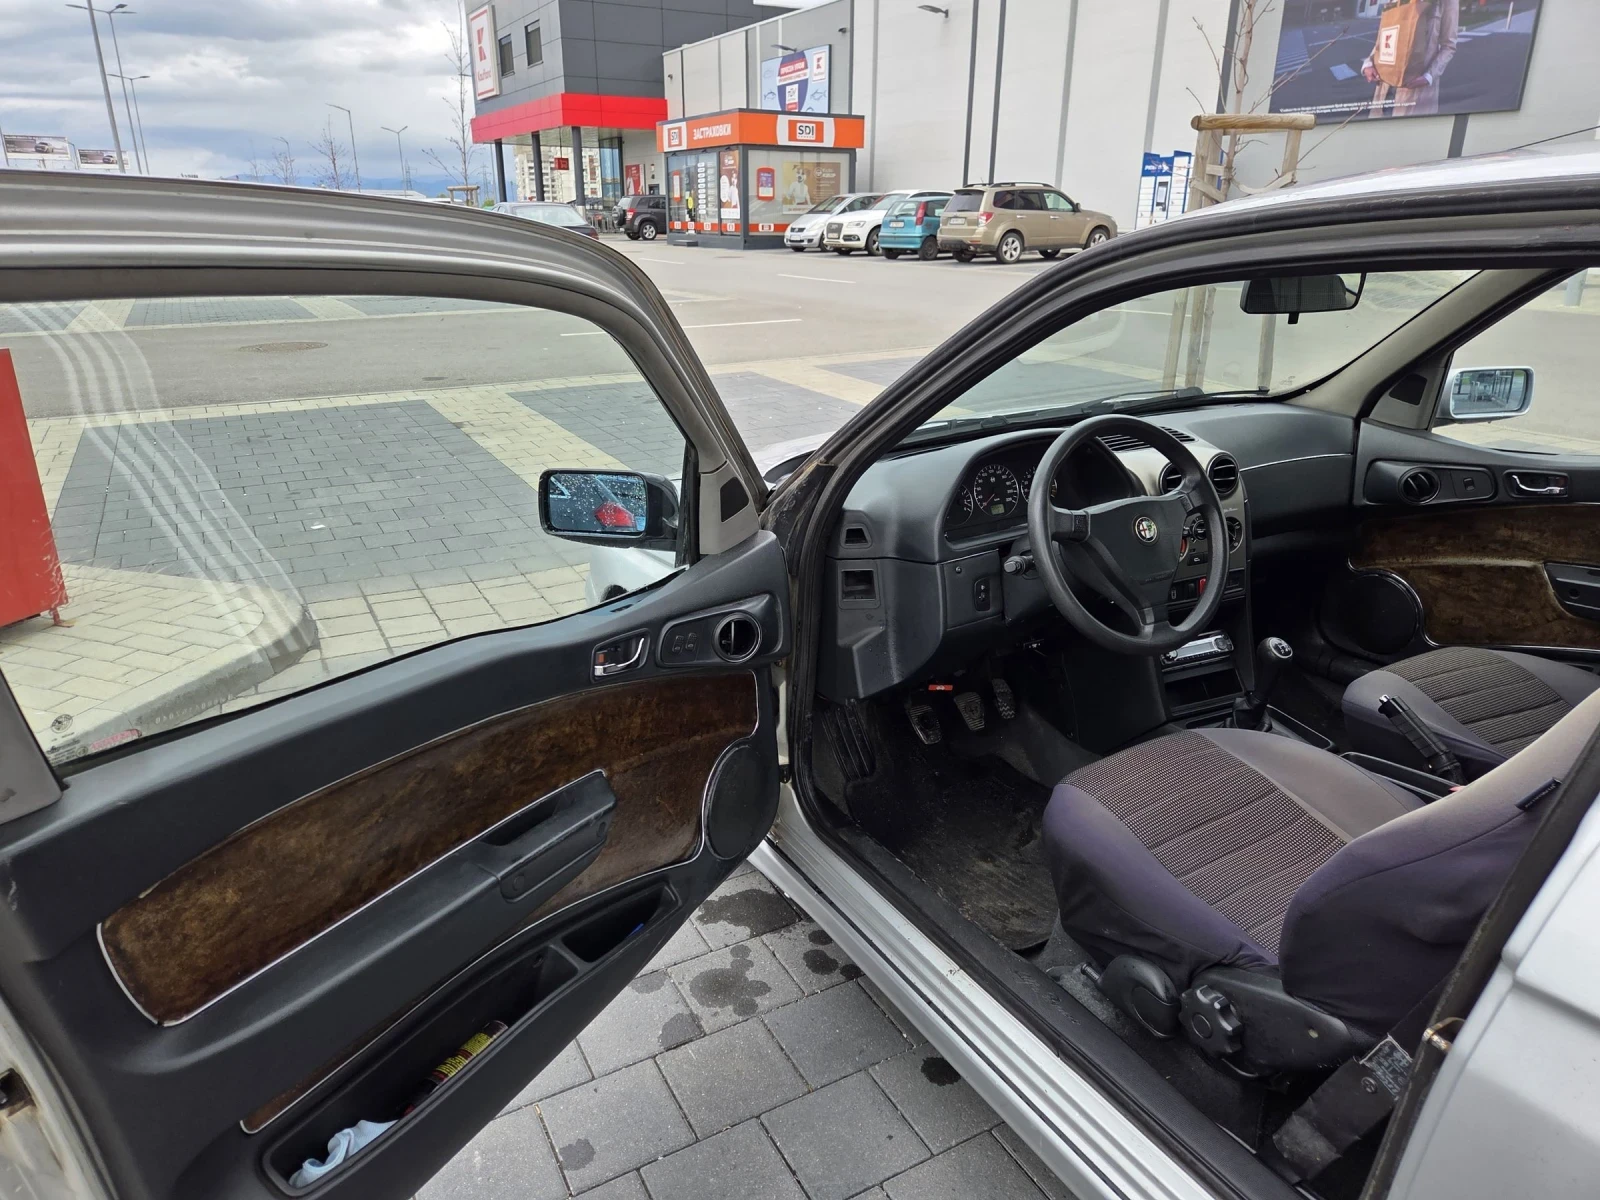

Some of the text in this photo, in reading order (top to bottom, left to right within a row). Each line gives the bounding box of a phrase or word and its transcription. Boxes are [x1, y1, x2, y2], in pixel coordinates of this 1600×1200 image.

[477, 27, 487, 62] K
[670, 131, 679, 141] SDI
[693, 123, 731, 140] ЗАСТРАХОВКИ
[798, 124, 814, 136] SDI
